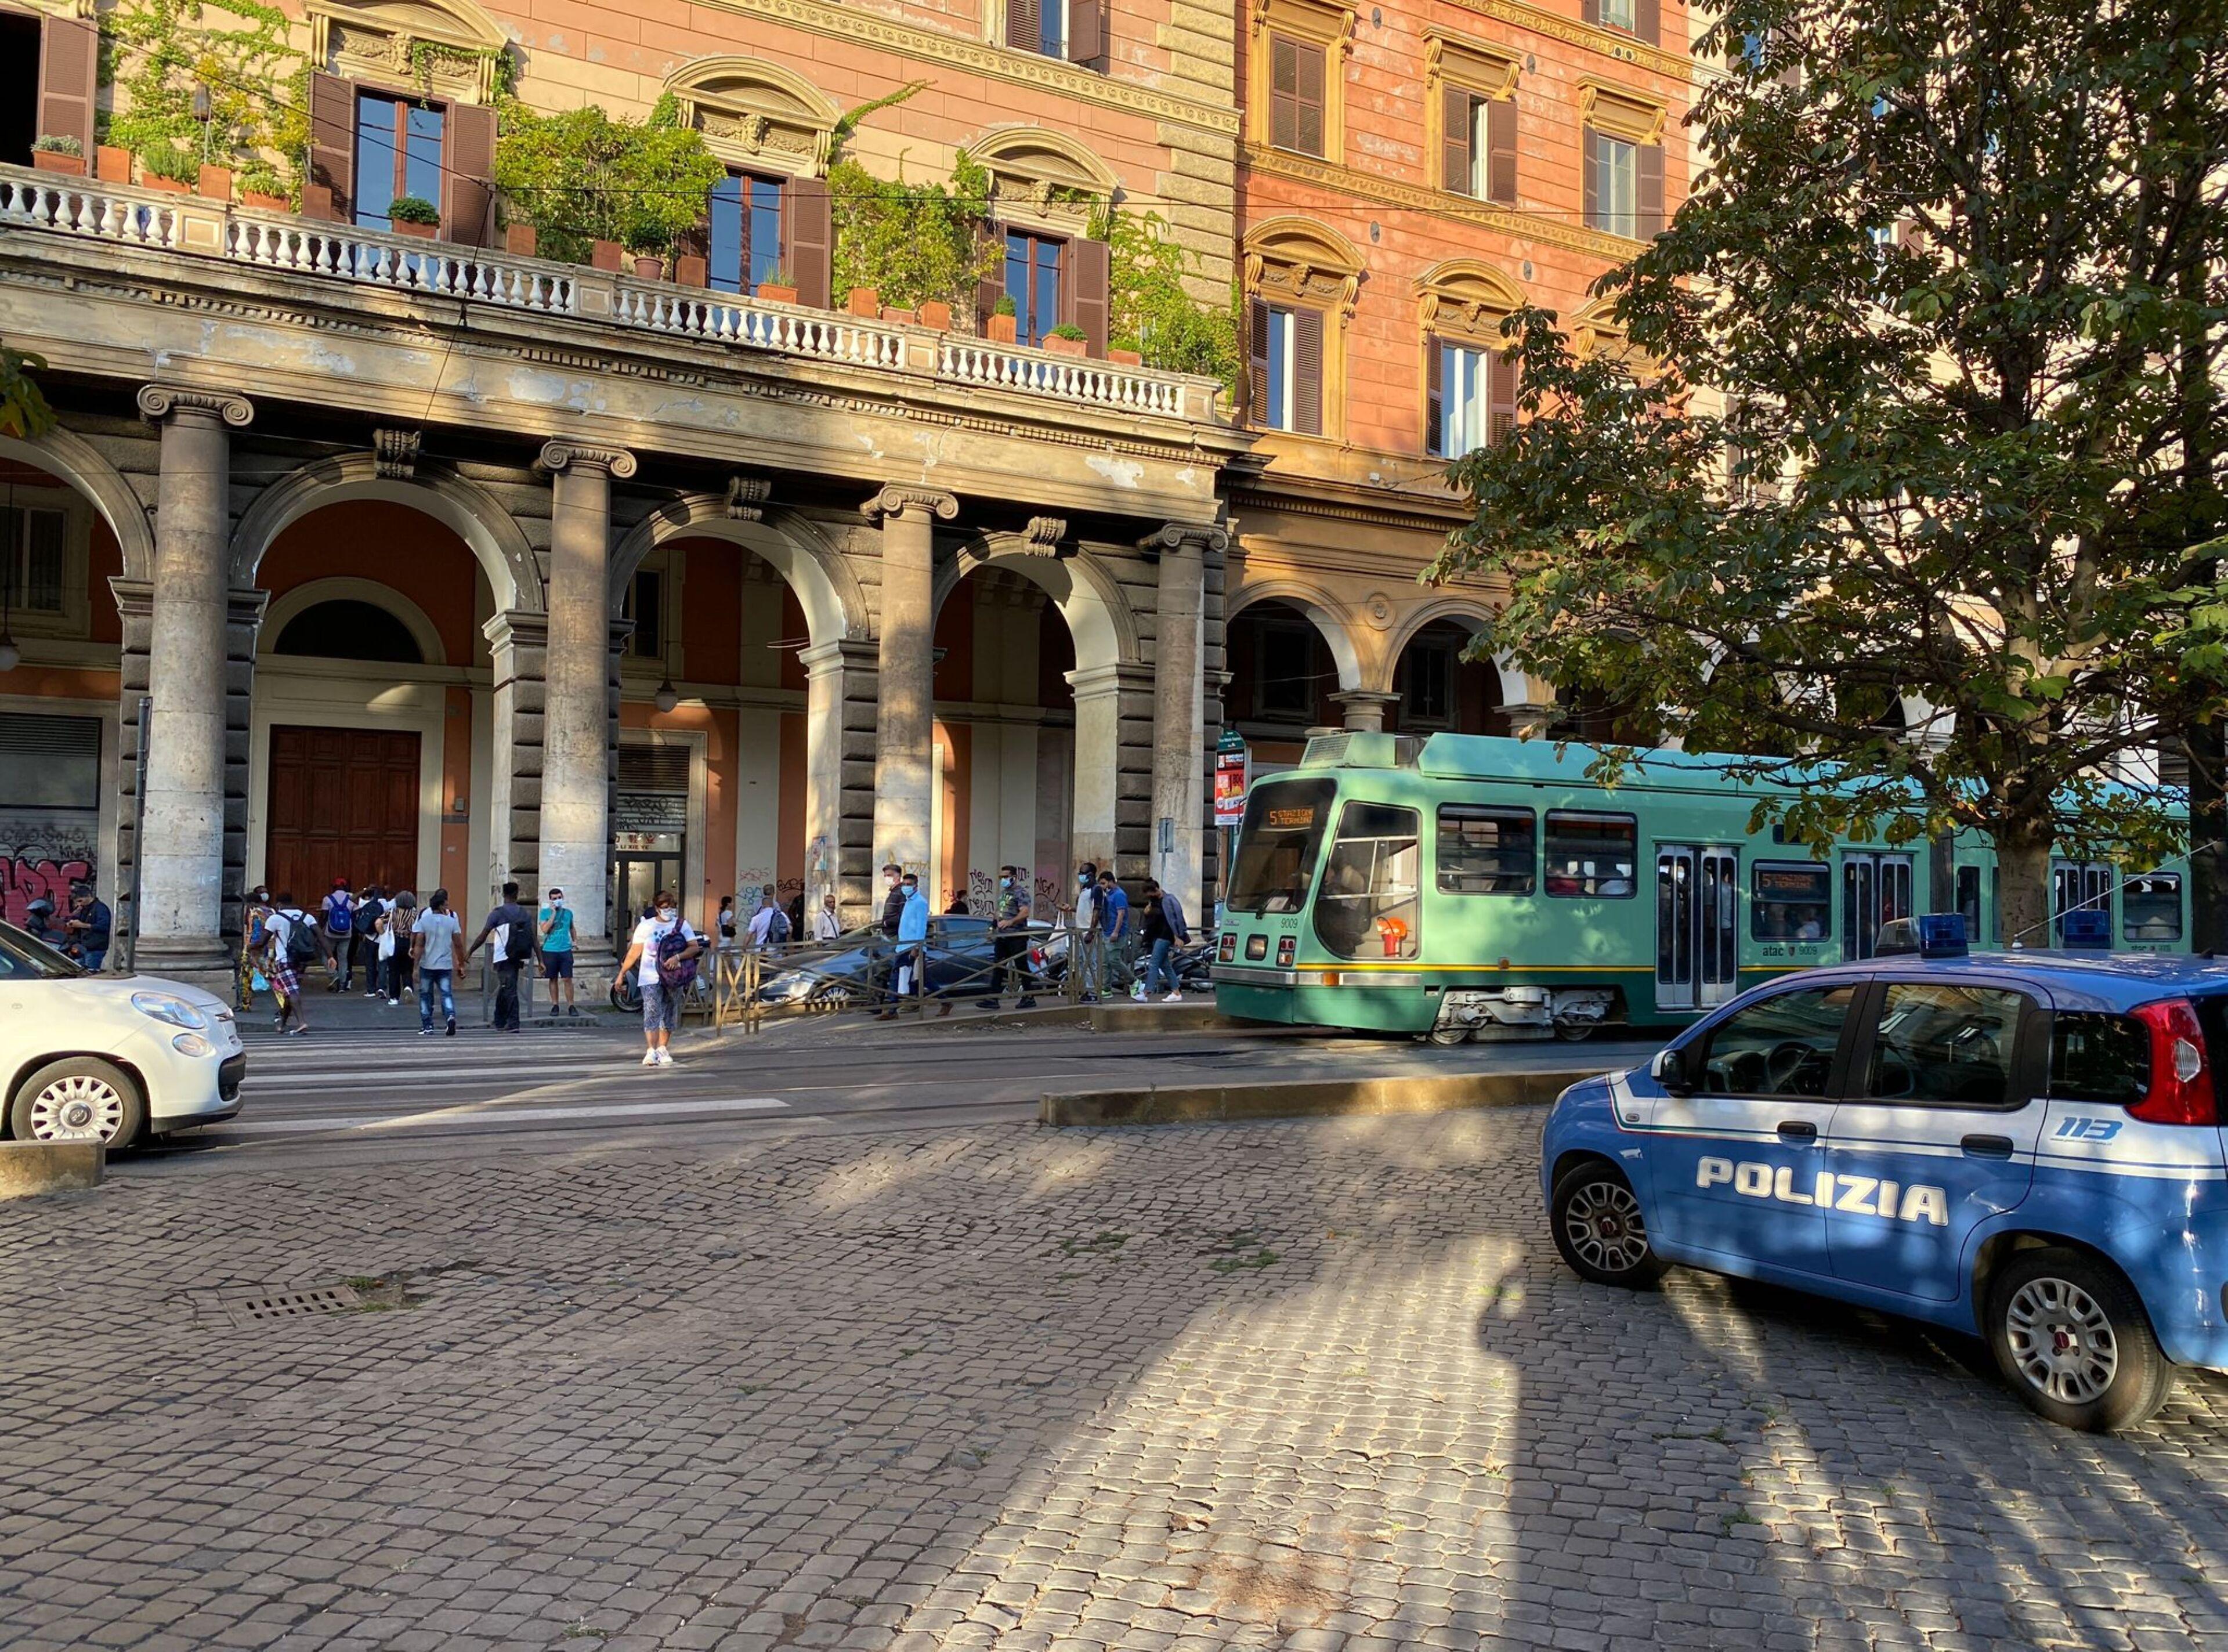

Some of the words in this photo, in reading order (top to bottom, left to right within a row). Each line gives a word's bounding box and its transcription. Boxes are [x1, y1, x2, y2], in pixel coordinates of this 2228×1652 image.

[1269, 811, 1277, 825] 5
[1281, 917, 1298, 928] 9009
[1763, 946, 1784, 956] atac
[2055, 1116, 2124, 1140] 113
[1696, 1155, 1950, 1227] POLIZIA
